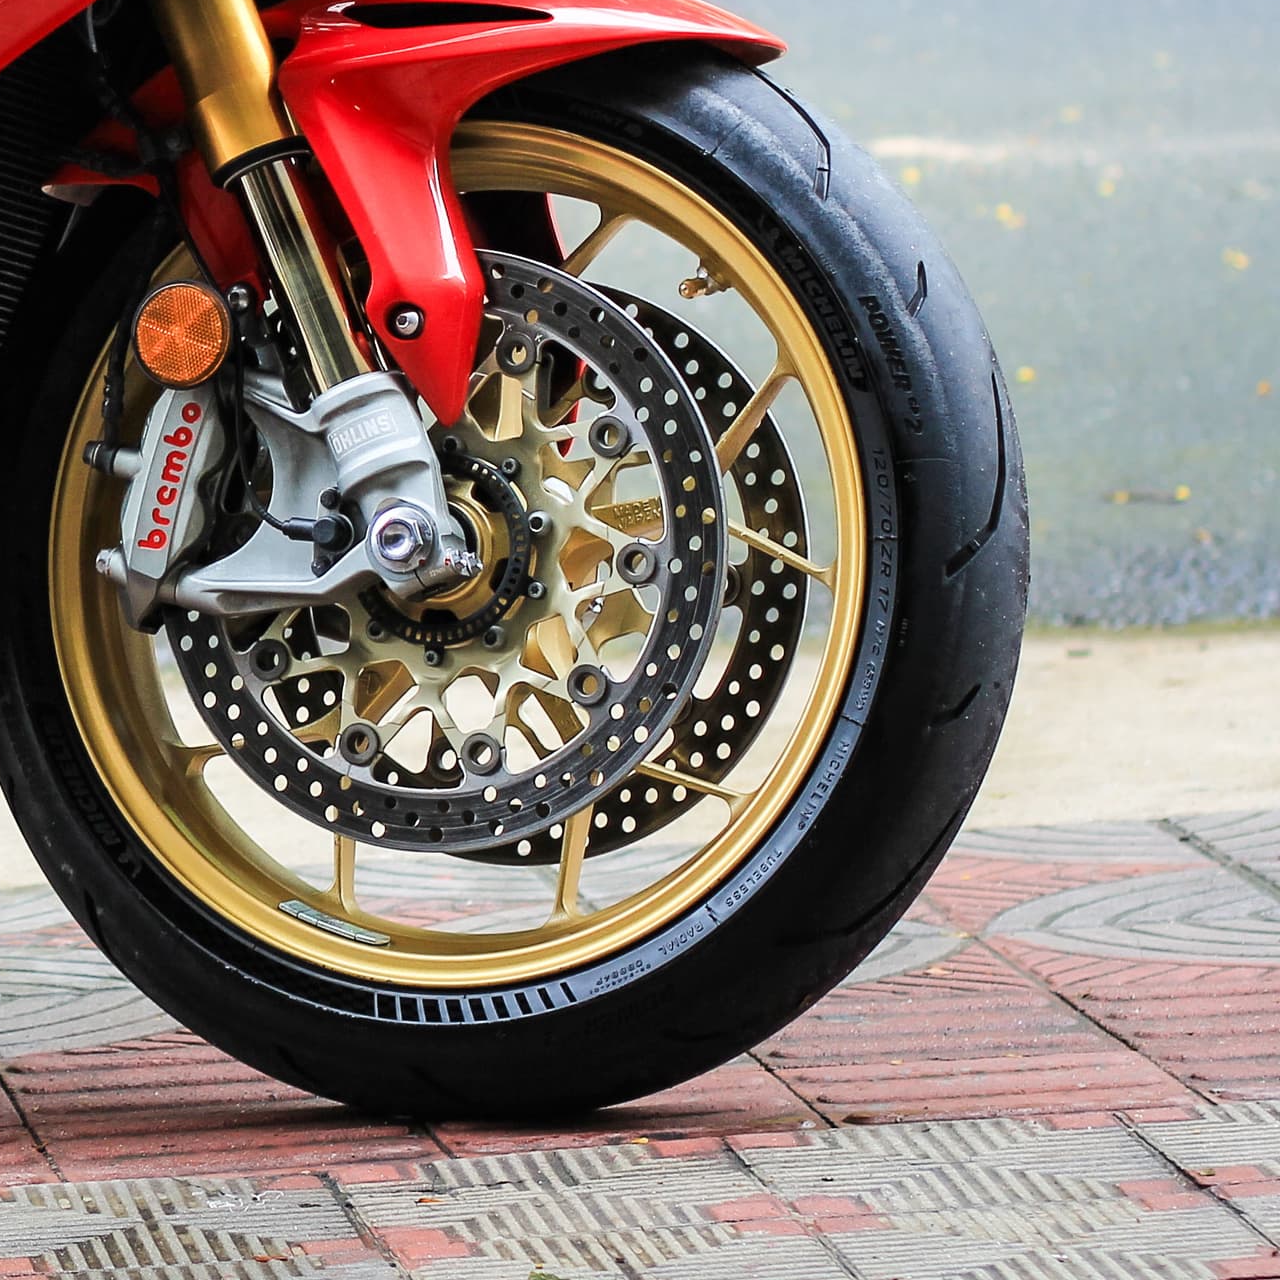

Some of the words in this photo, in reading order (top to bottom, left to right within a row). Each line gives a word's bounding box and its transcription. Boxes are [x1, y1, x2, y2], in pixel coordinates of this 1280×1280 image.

[778, 243, 867, 383] MICHELIN
[857, 294, 913, 393] POWER
[137, 401, 203, 551] brembo
[872, 448, 891, 535] 120/70
[725, 847, 783, 907] TUBELESS
[657, 921, 704, 955] RADIAL
